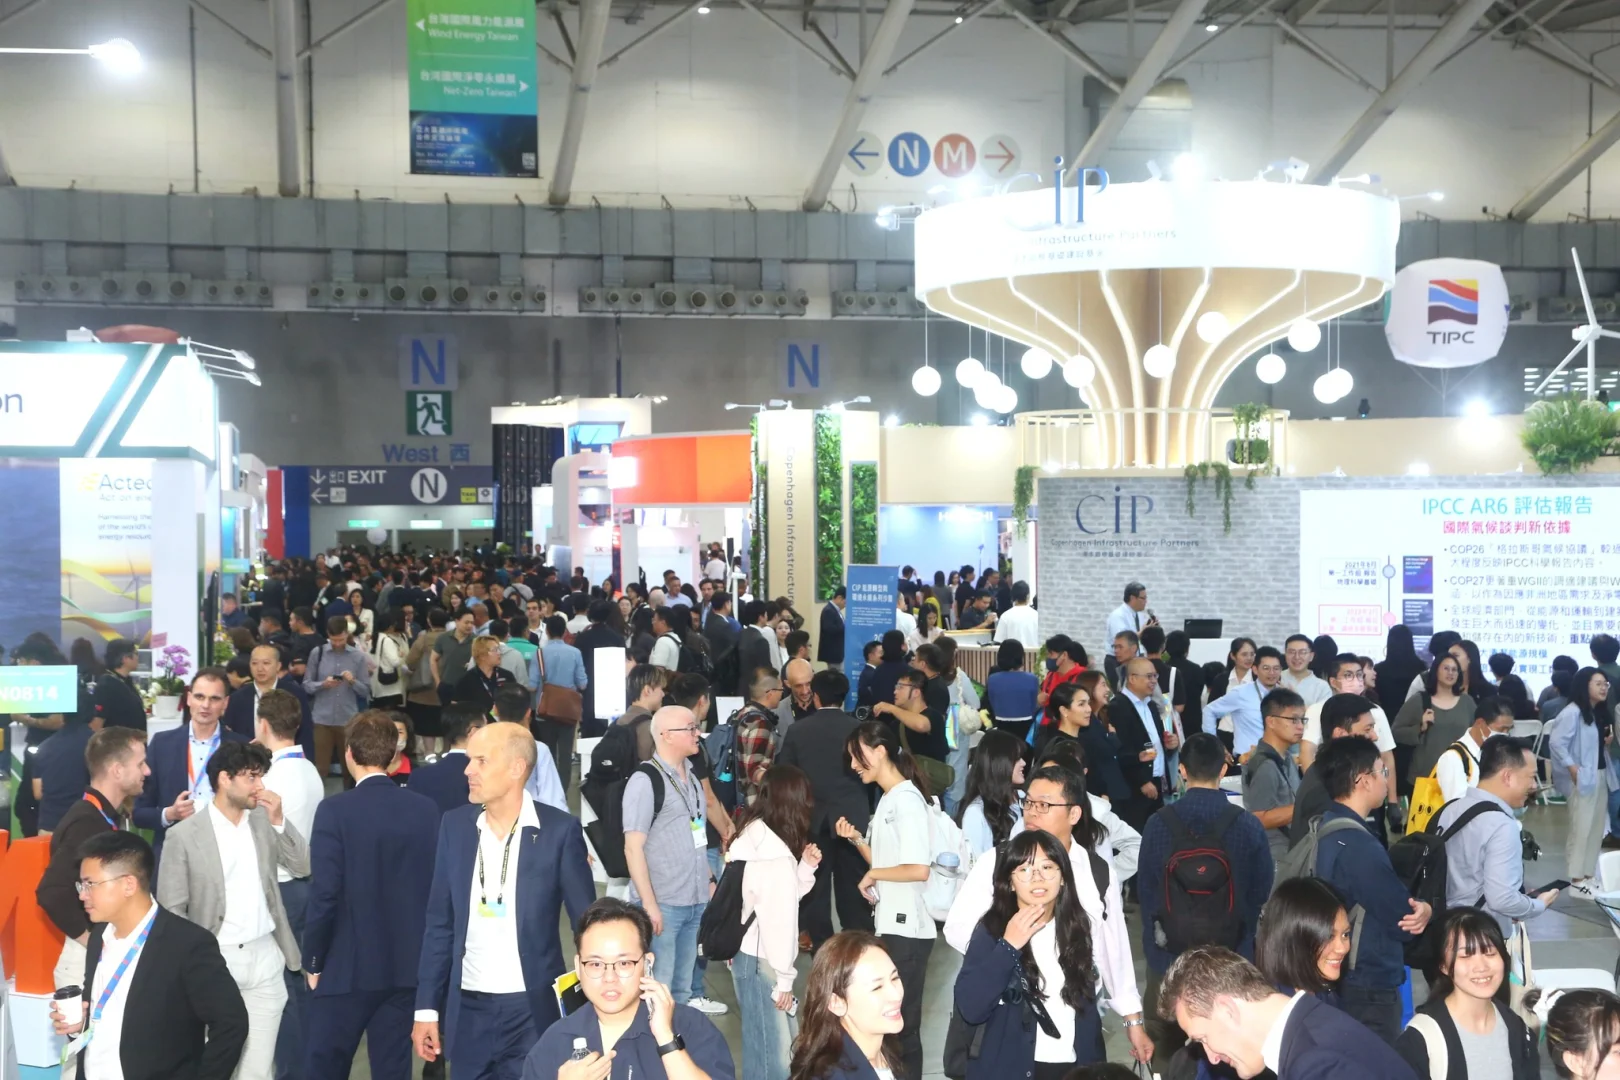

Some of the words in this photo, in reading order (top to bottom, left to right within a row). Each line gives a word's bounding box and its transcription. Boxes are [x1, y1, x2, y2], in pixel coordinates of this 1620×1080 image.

[428, 28, 453, 40] Wind
[454, 29, 485, 42] Energy
[488, 30, 519, 41] Taiwan
[444, 86, 484, 96] Net-Zero
[486, 87, 517, 97] Taiwan
[898, 139, 920, 169] N
[942, 142, 967, 170] M
[1426, 331, 1476, 344] TIPC
[412, 339, 445, 385] N
[787, 344, 820, 388] N
[382, 444, 439, 462] West
[450, 444, 471, 463] 西
[348, 470, 387, 484] EXIT
[419, 473, 439, 498] N
[1422, 499, 1464, 515] IPCC
[1470, 498, 1508, 515] AR6
[1514, 496, 1592, 516] 評估報告
[1443, 520, 1571, 534] 國際氣候談判新依據
[1094, 538, 1158, 547] Infrastructure
[1160, 538, 1199, 547] Partners
